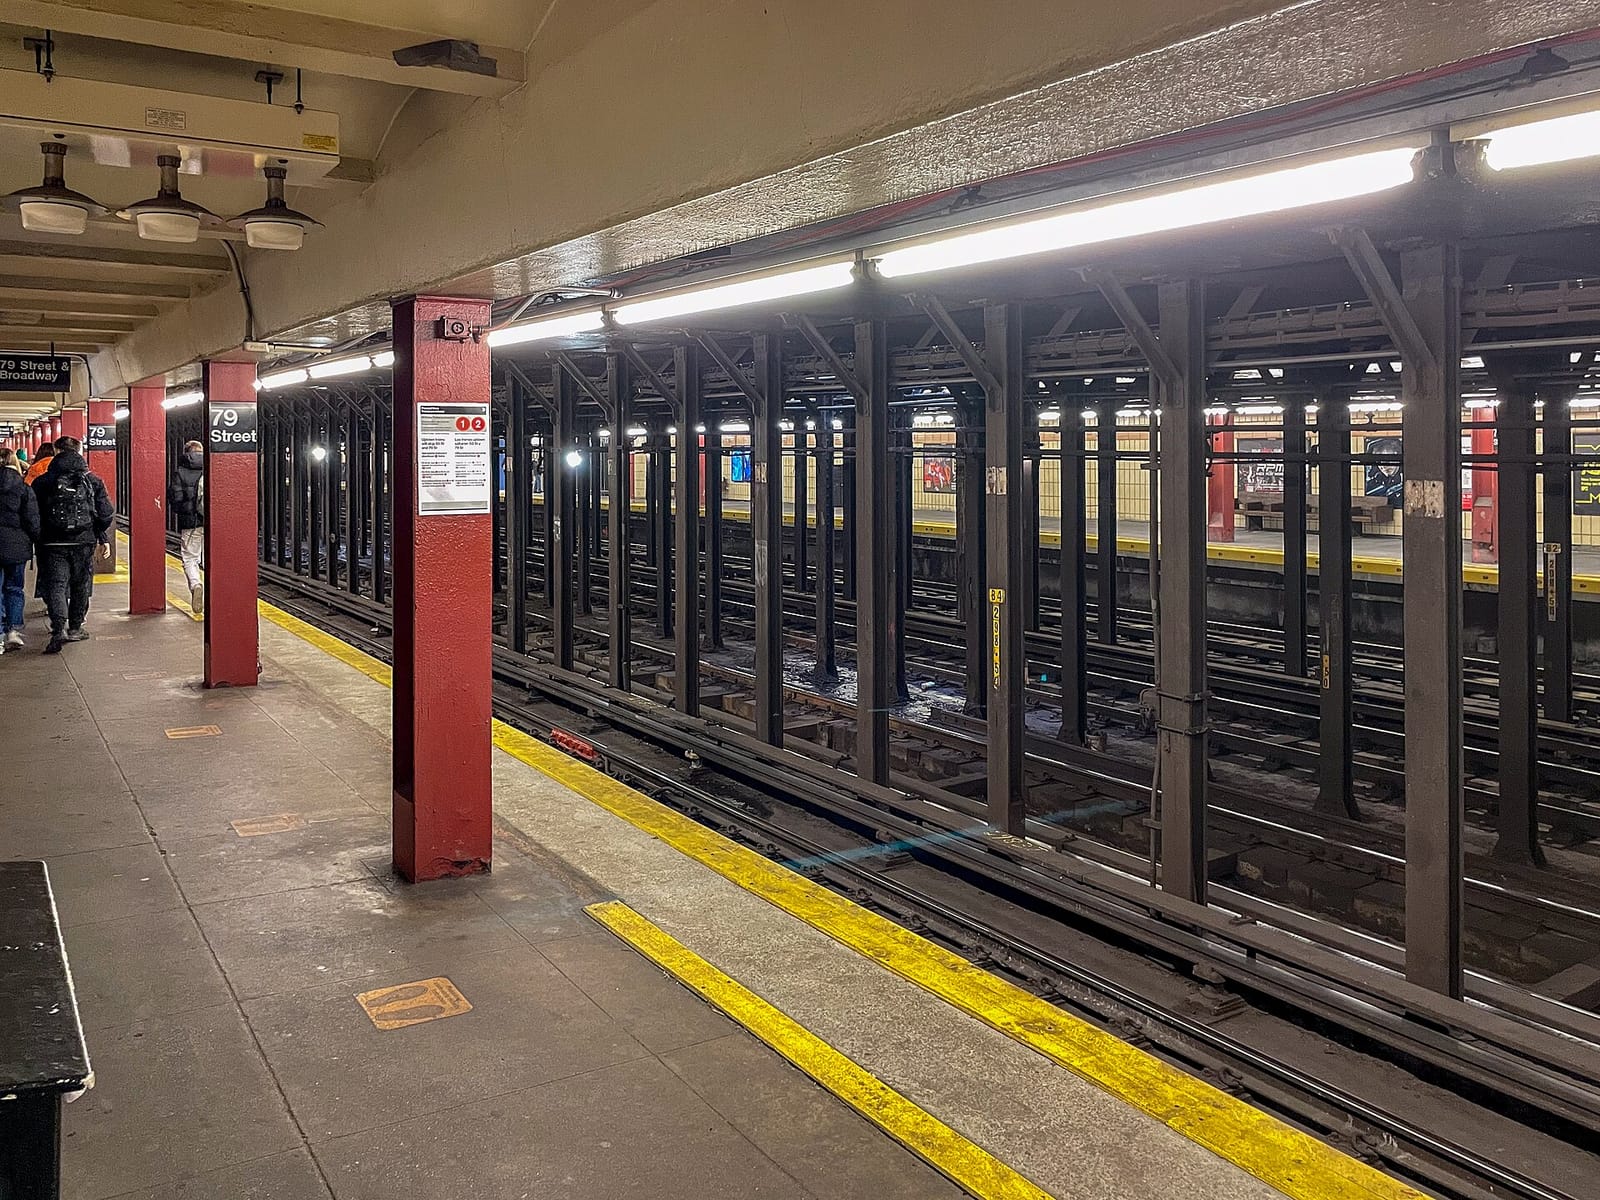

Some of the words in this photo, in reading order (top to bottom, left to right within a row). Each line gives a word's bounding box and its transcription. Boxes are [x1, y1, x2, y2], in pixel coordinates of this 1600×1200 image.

[0, 359, 16, 370] 79
[20, 360, 57, 371] Street
[61, 361, 70, 371] &
[0, 370, 58, 382] Broadway
[211, 409, 238, 427] 79
[89, 427, 105, 437] 79
[210, 429, 257, 443] Street
[89, 438, 116, 446] Street
